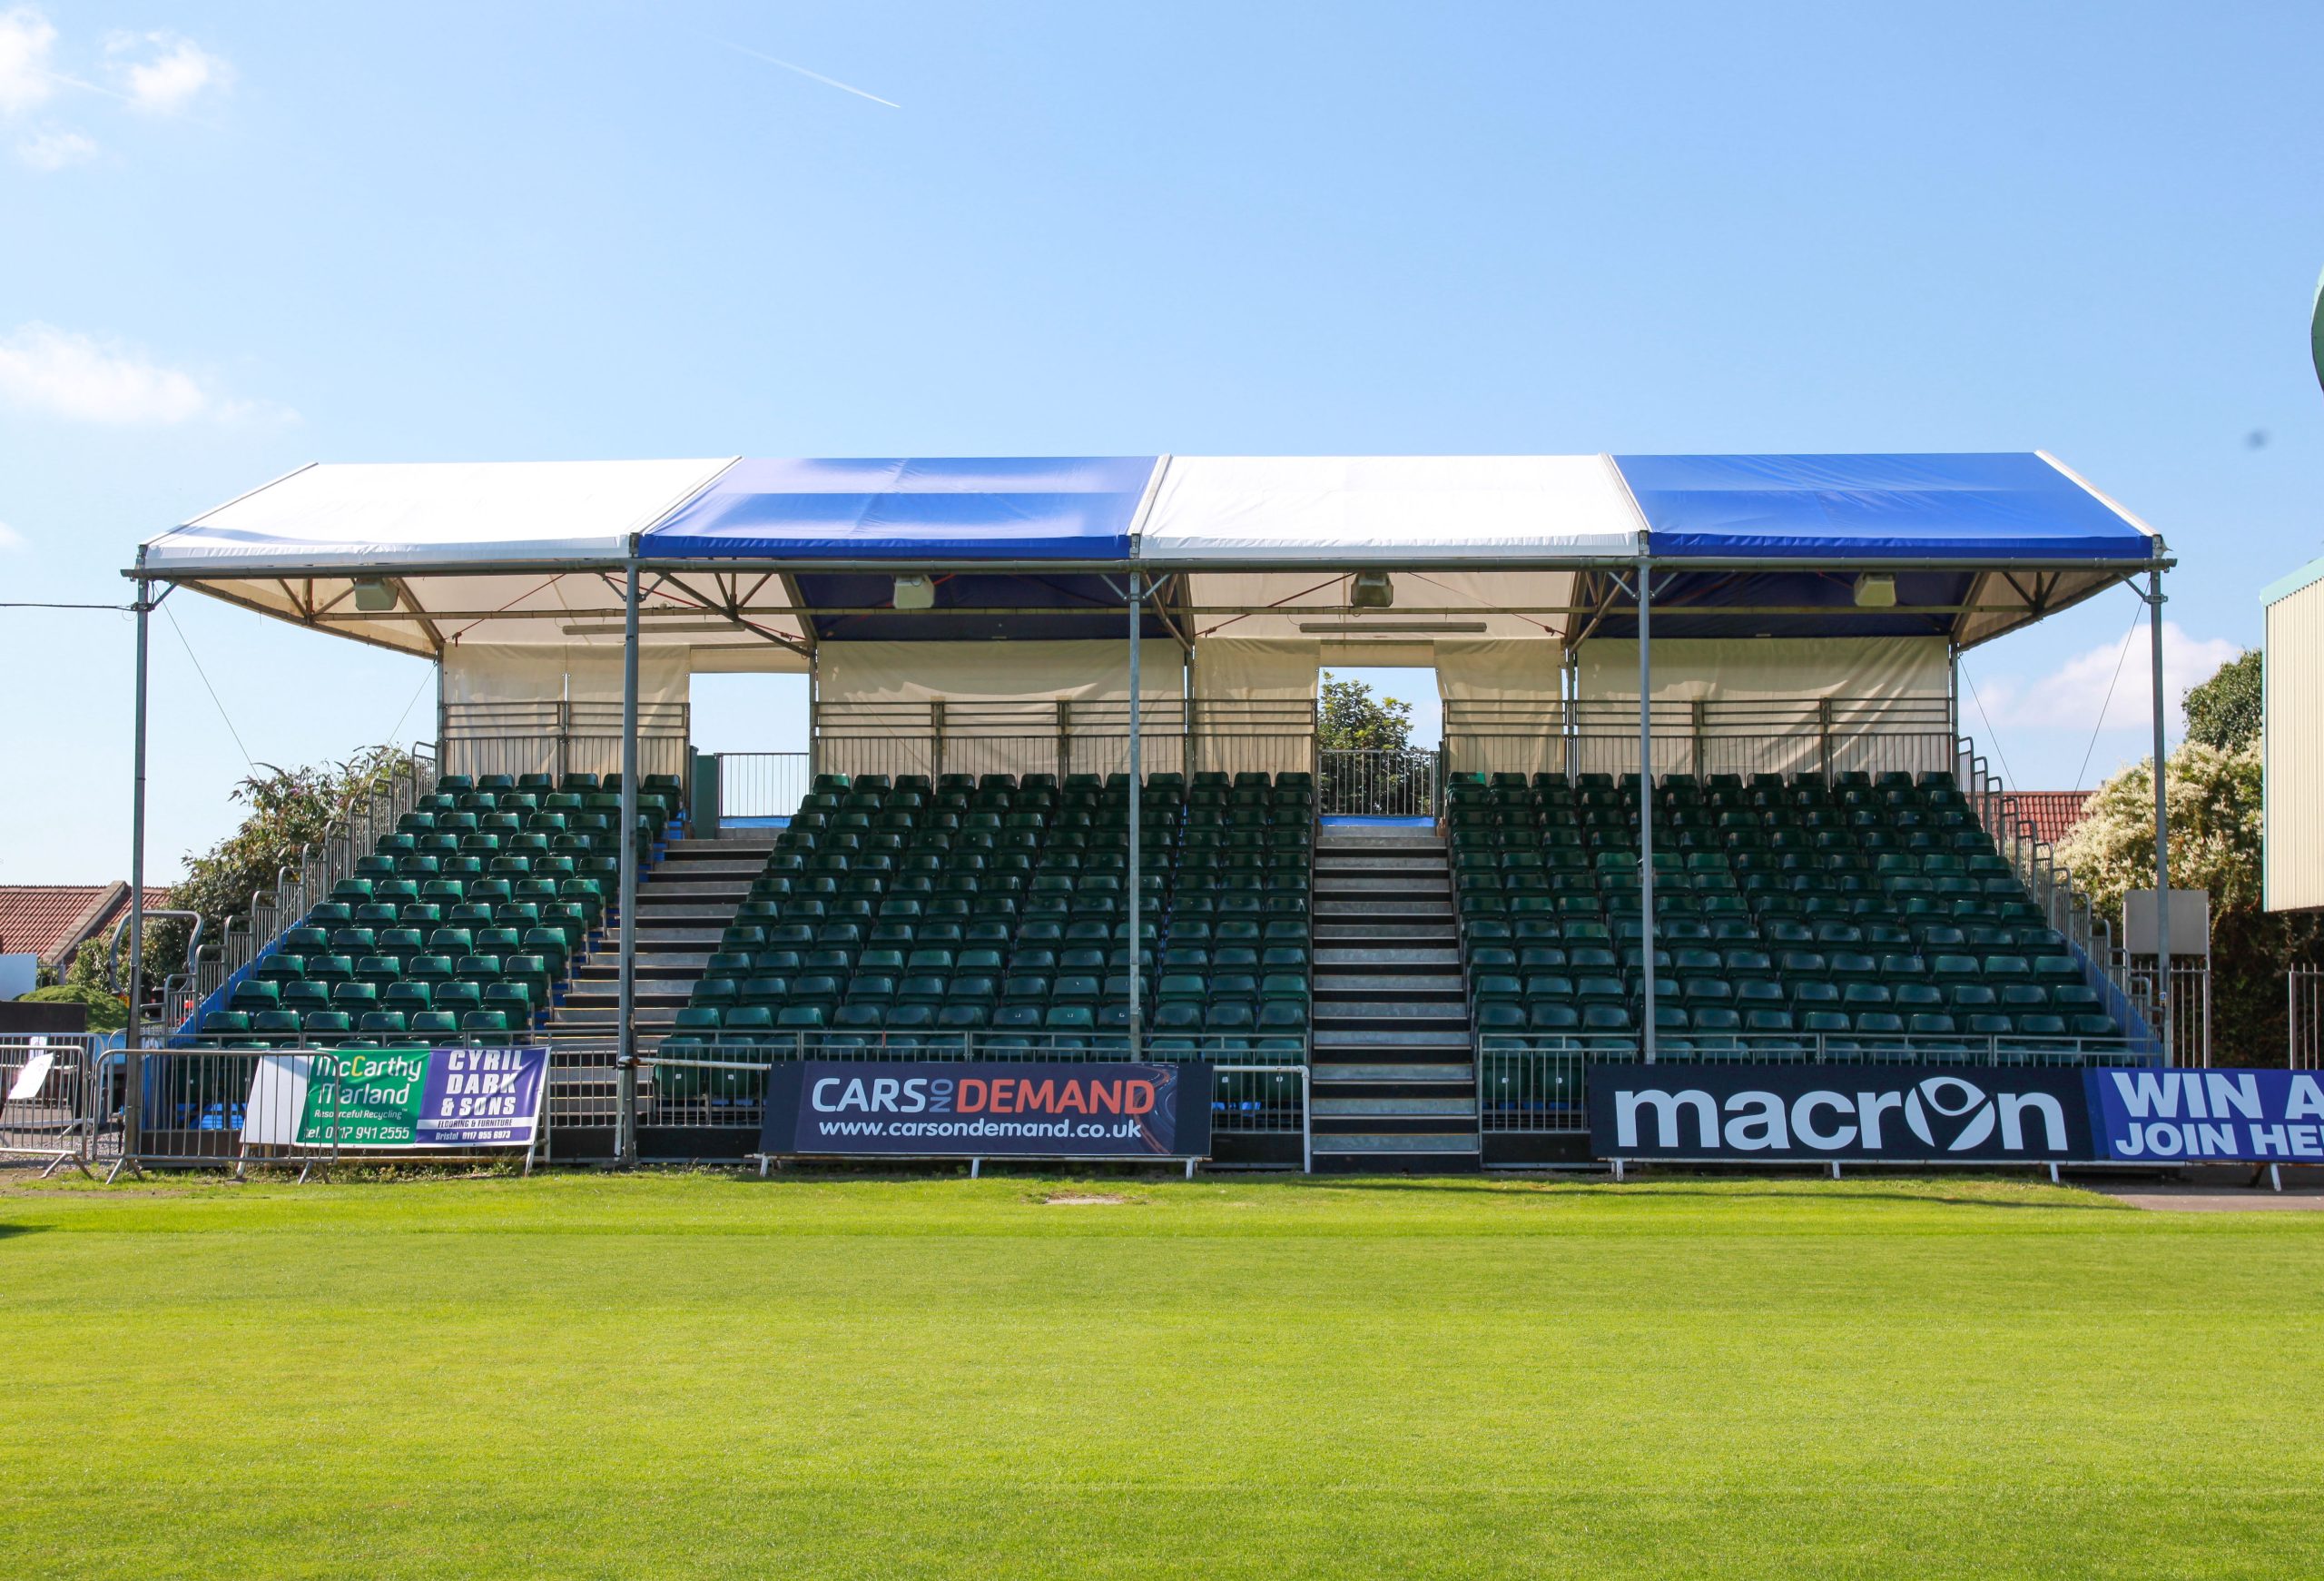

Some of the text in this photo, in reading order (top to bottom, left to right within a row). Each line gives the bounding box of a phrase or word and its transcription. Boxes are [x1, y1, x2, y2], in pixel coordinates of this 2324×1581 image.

[317, 1055, 422, 1082] McCarthy
[448, 1050, 523, 1071] CYRIL
[447, 1073, 517, 1094] DARK
[441, 1096, 517, 1116] & SONS
[812, 1078, 927, 1112] CARS
[956, 1079, 1155, 1114] DEMAND
[2111, 1072, 2263, 1119] WIN
[314, 1109, 363, 1118] Resorceful
[438, 1120, 470, 1128] FLOORING
[478, 1119, 512, 1127] FURNITURE
[1615, 1076, 2068, 1151] macron
[355, 1126, 378, 1139] 941
[379, 1126, 410, 1139] 2555
[436, 1131, 458, 1141] Bristol
[462, 1131, 477, 1140] 0117
[493, 1131, 511, 1139] 6973
[819, 1118, 1142, 1138] www.carsondemand.co.uk
[2115, 1122, 2324, 1156] JOIN HE
